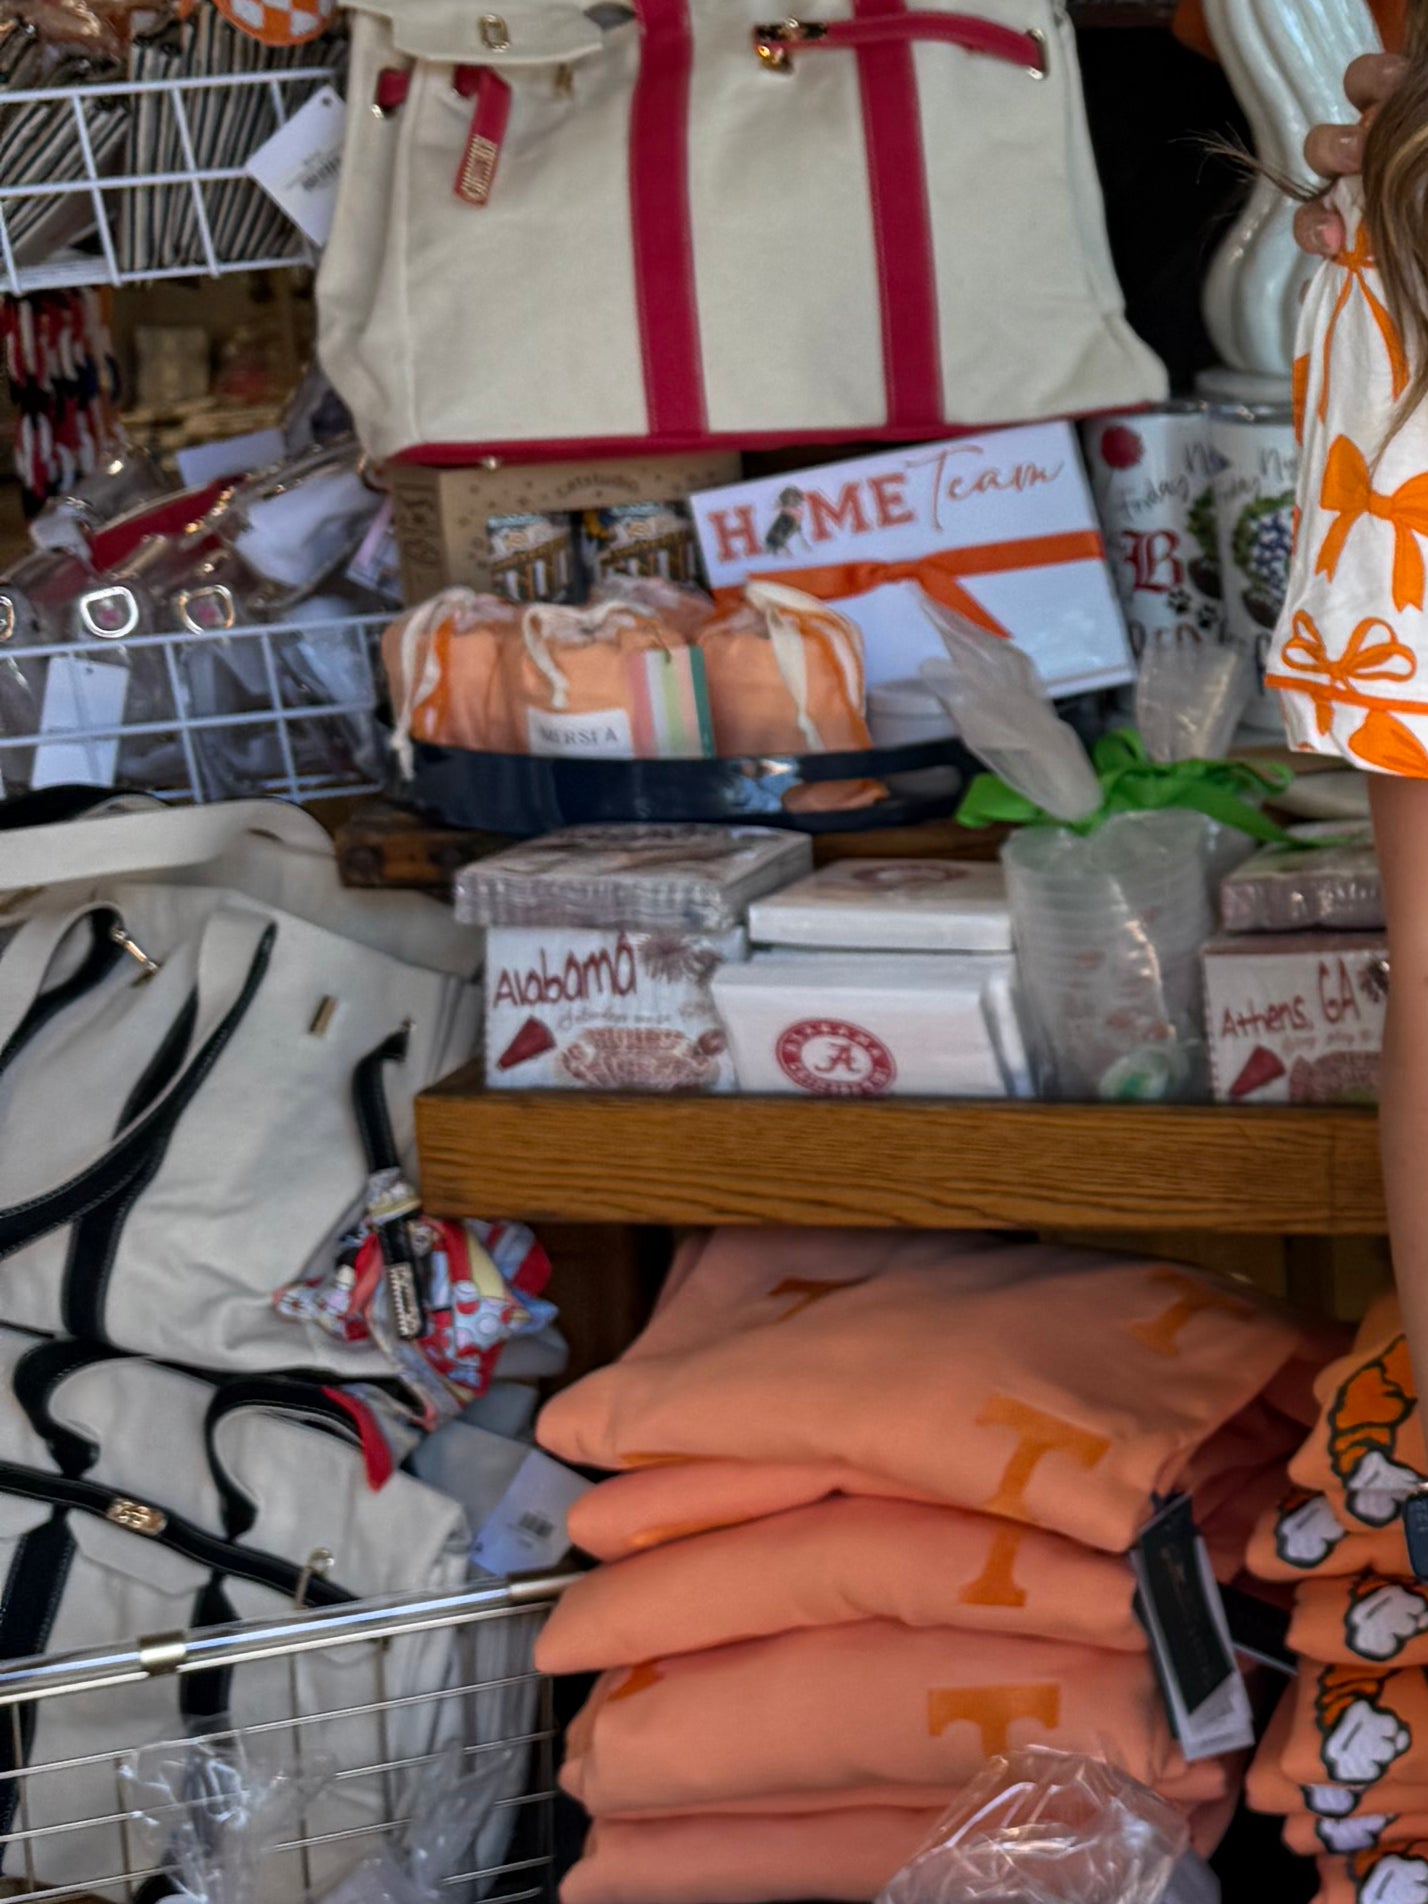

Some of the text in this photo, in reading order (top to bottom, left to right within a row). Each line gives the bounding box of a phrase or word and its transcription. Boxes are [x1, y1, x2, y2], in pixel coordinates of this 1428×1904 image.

[707, 444, 1065, 564] HME Team
[493, 928, 638, 1009] Alabama
[1318, 957, 1361, 1024] GA
